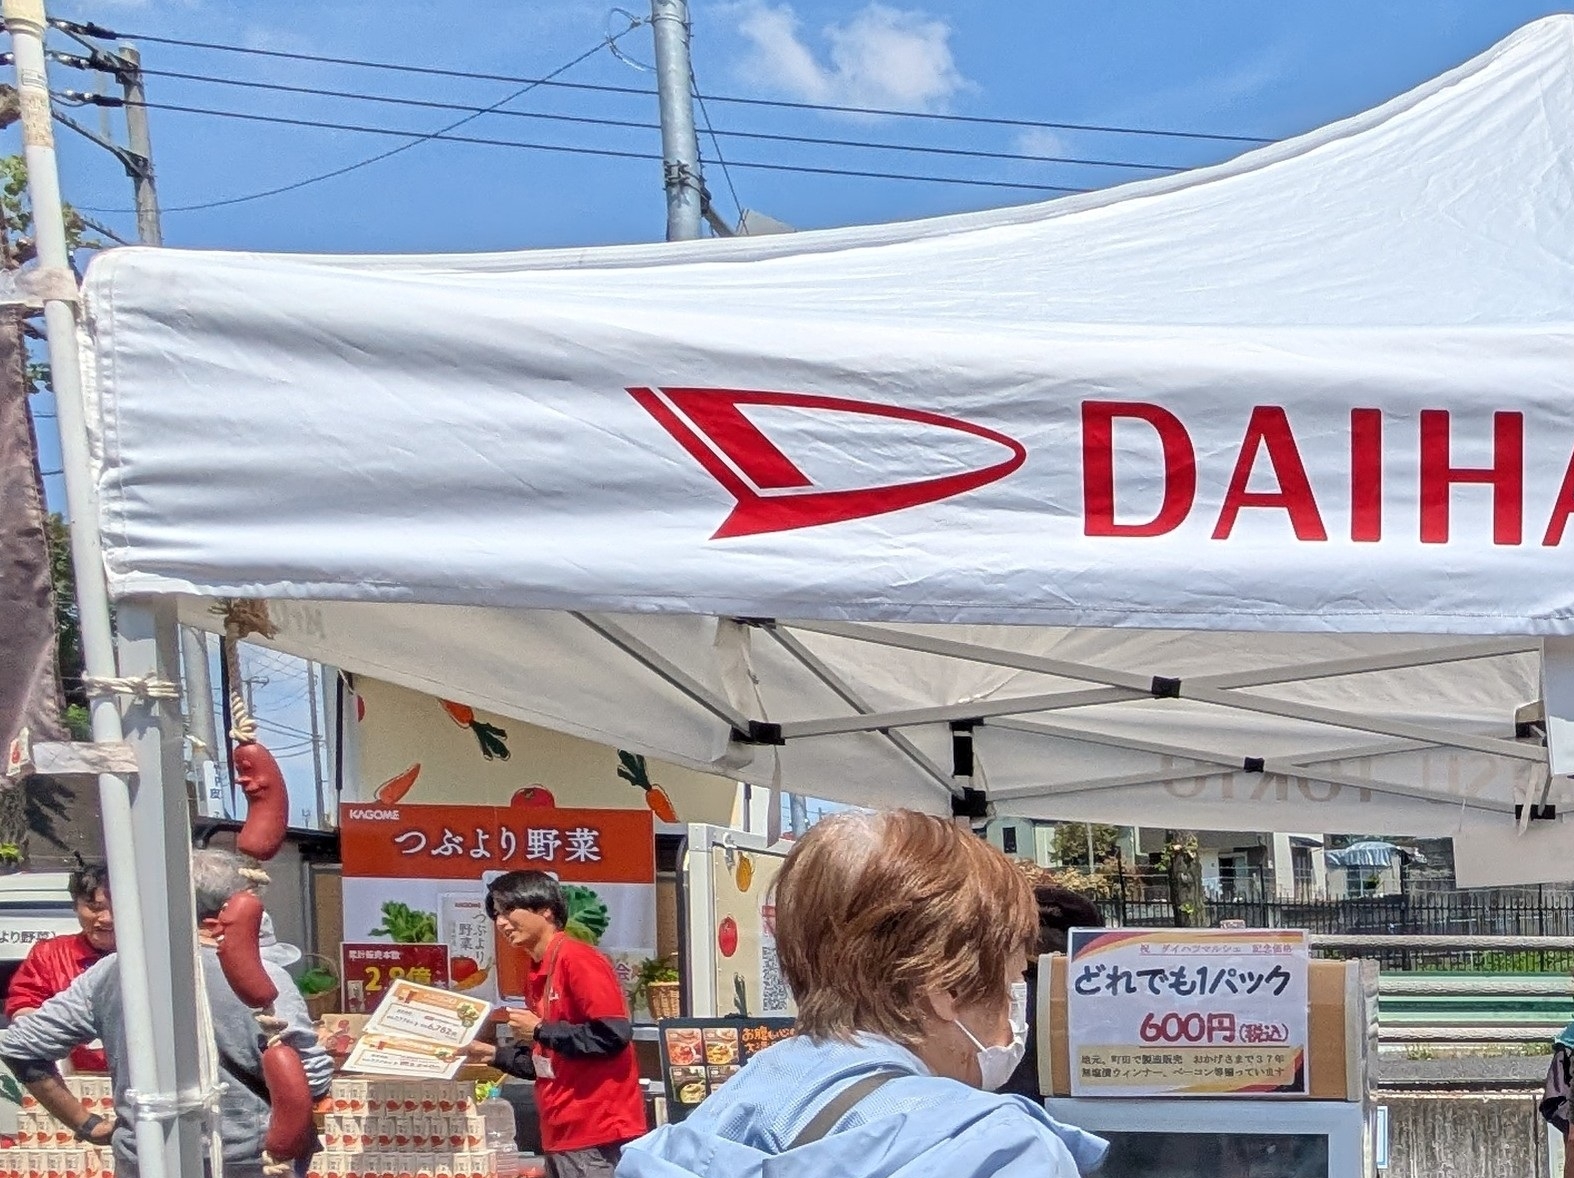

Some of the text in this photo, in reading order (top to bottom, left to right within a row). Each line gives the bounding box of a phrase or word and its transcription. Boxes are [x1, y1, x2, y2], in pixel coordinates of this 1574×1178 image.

[349, 809, 400, 821] KAGOME
[394, 825, 602, 863] つぶより野菜
[1074, 964, 1291, 997] どれでも1パック
[1139, 1012, 1289, 1044] 600円(税込)
